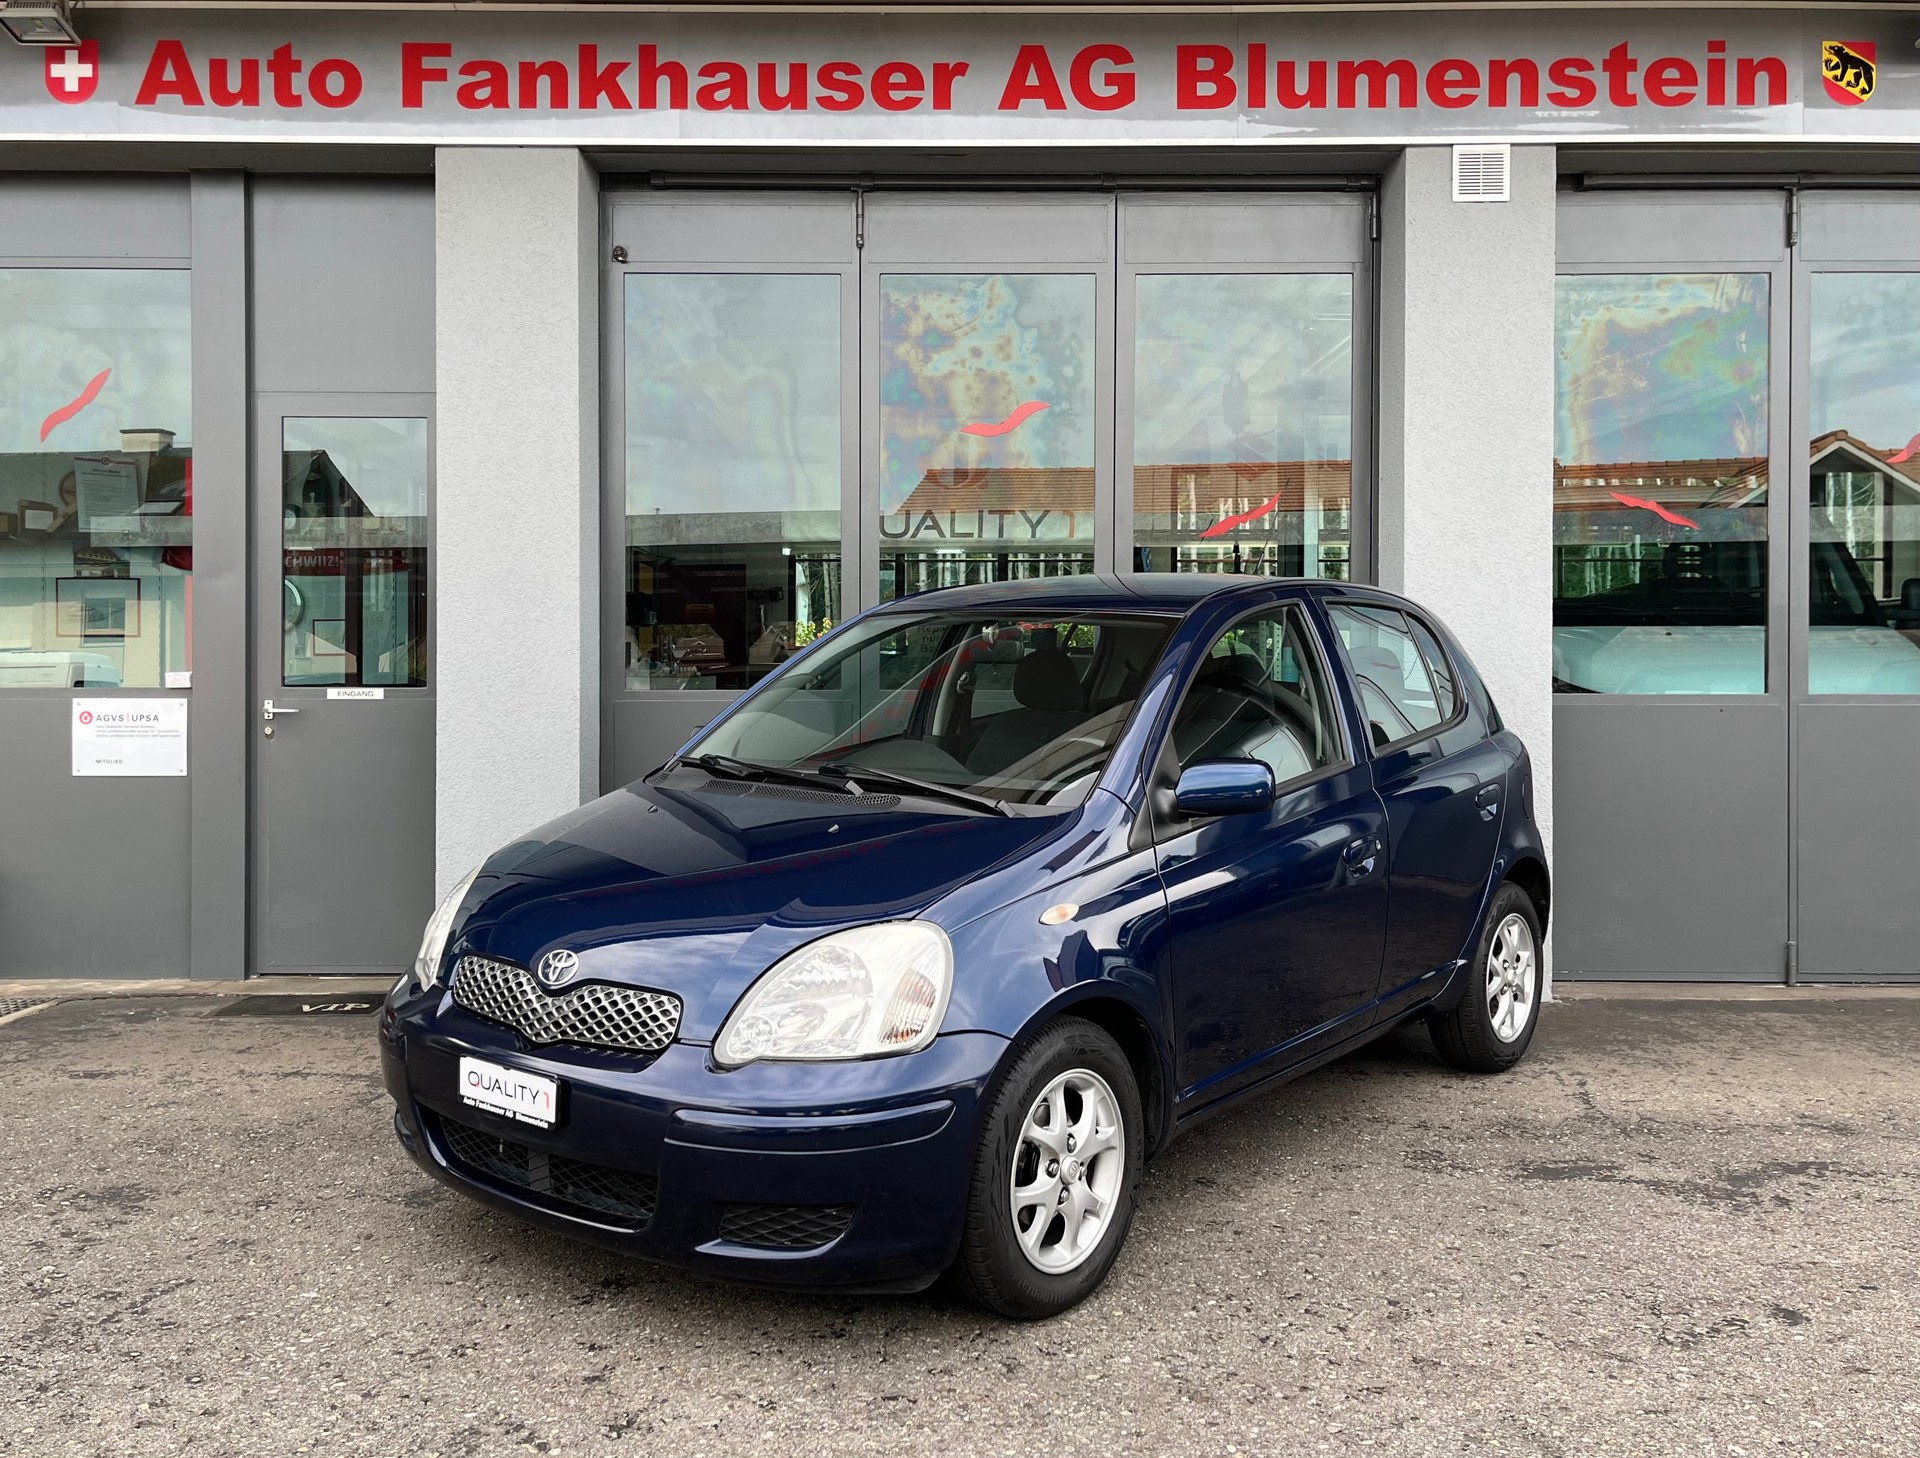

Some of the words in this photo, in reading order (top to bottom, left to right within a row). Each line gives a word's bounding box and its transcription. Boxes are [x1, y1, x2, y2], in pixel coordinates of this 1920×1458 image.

[135, 40, 362, 108] Auto
[402, 43, 969, 111] Fankhauser
[999, 44, 1136, 111] AG
[1177, 40, 1787, 110] Blumenstein
[879, 509, 1051, 539] UALITY
[285, 555, 340, 568] CHWIIZ!
[95, 714, 124, 722] AGVS
[131, 714, 159, 722] UPSA
[468, 1070, 540, 1105] QUALITY
